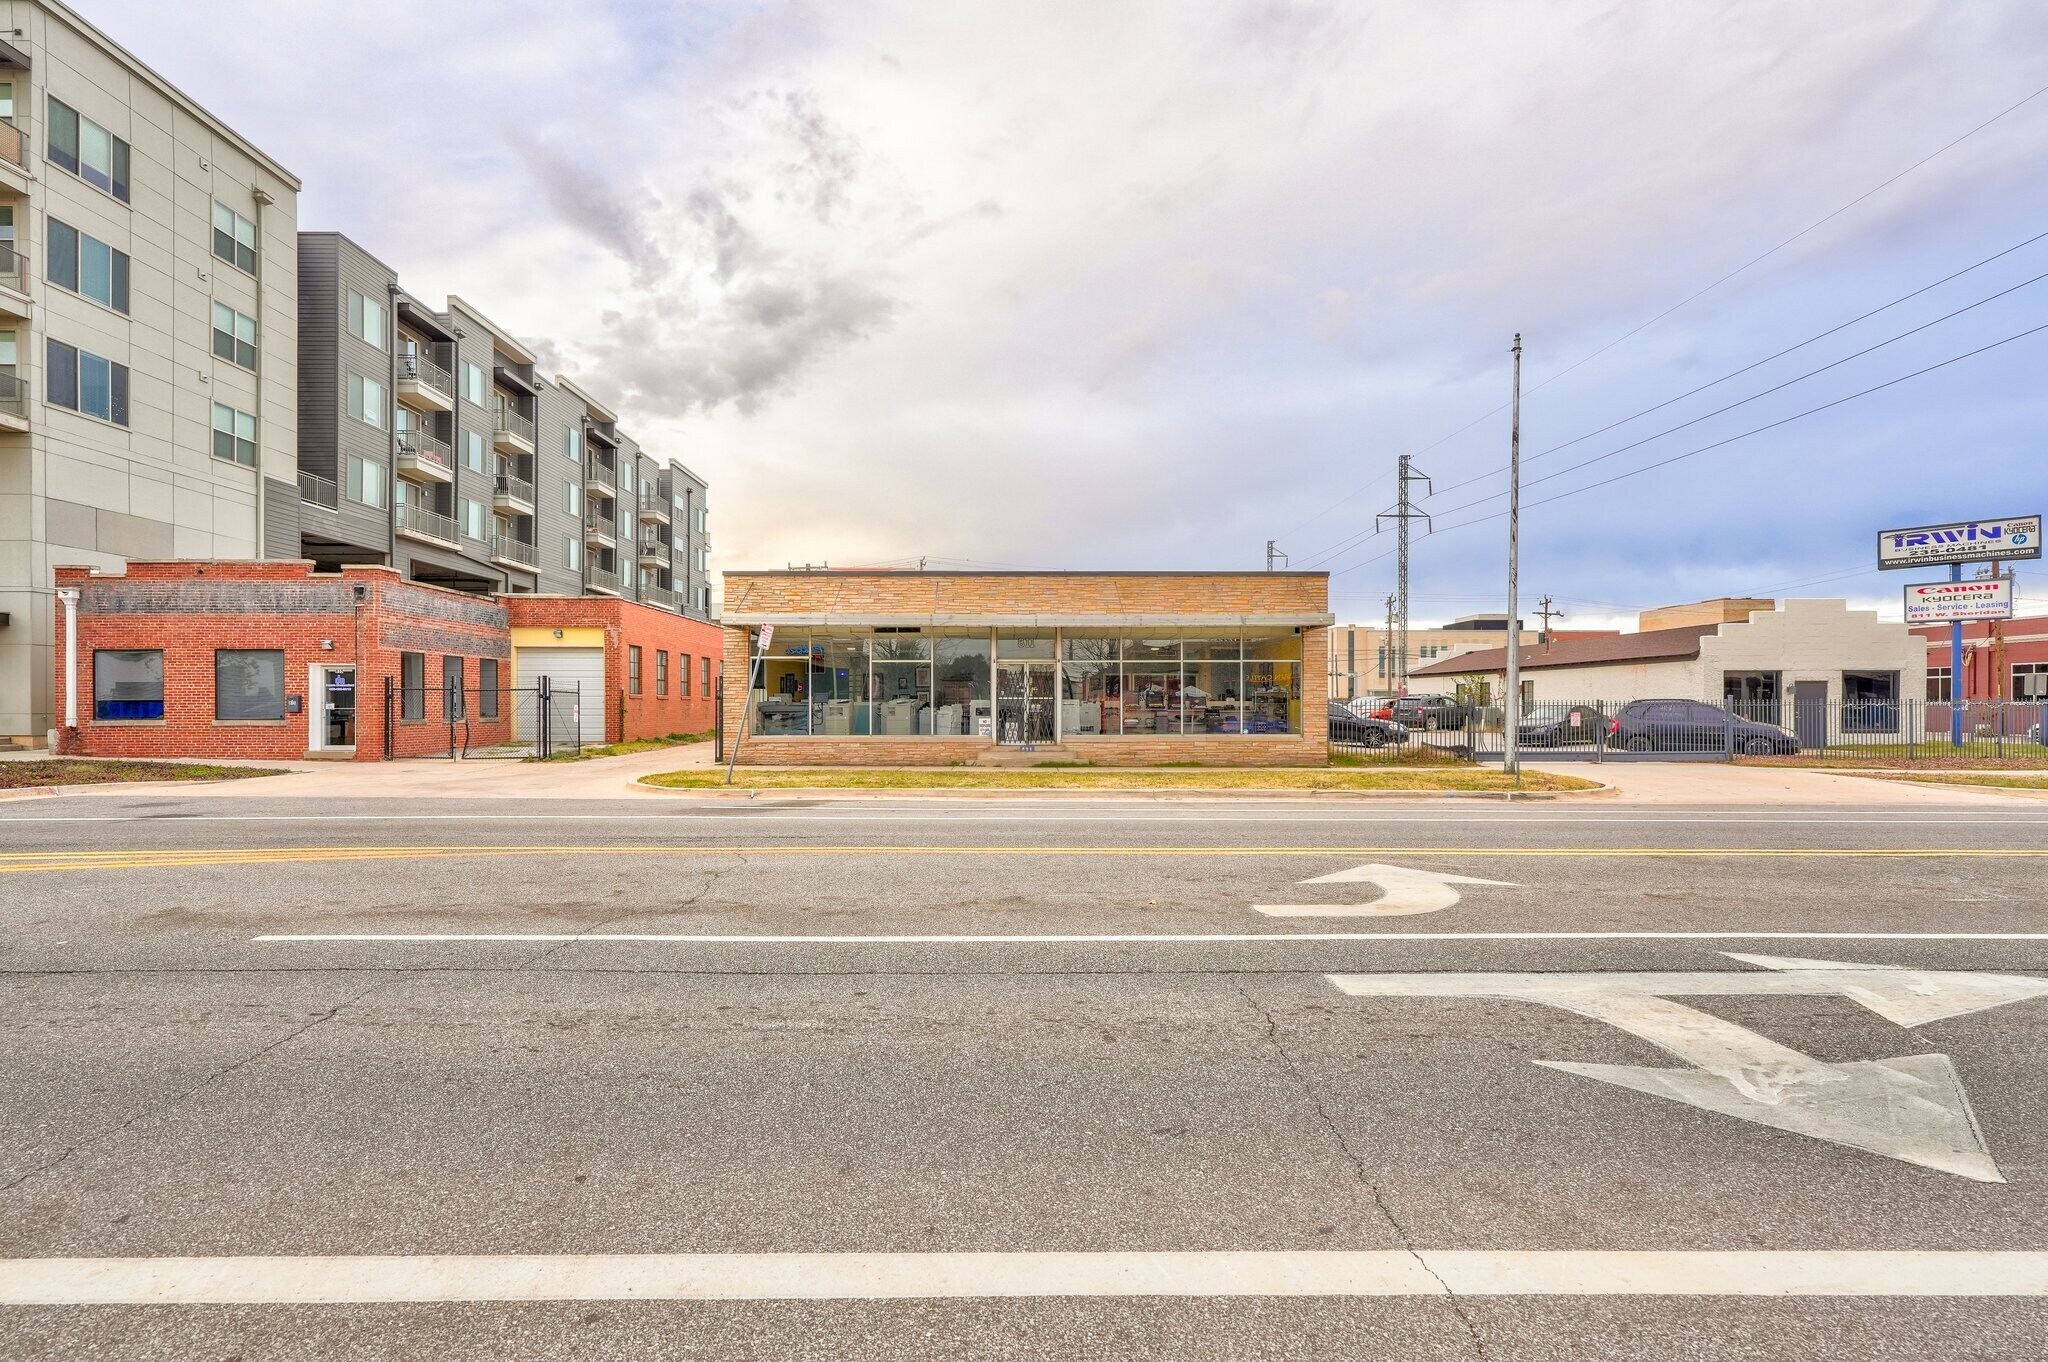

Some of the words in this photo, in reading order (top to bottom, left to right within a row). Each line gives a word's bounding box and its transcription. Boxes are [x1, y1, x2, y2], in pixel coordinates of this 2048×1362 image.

[2013, 534, 2026, 545] hp
[1909, 545, 1987, 556] 235-0481
[1884, 551, 2035, 565] www.irwinbusinessmachines.com
[1917, 584, 1998, 594] Canon
[1937, 602, 1968, 610] Service
[1976, 600, 2009, 609] Leasing
